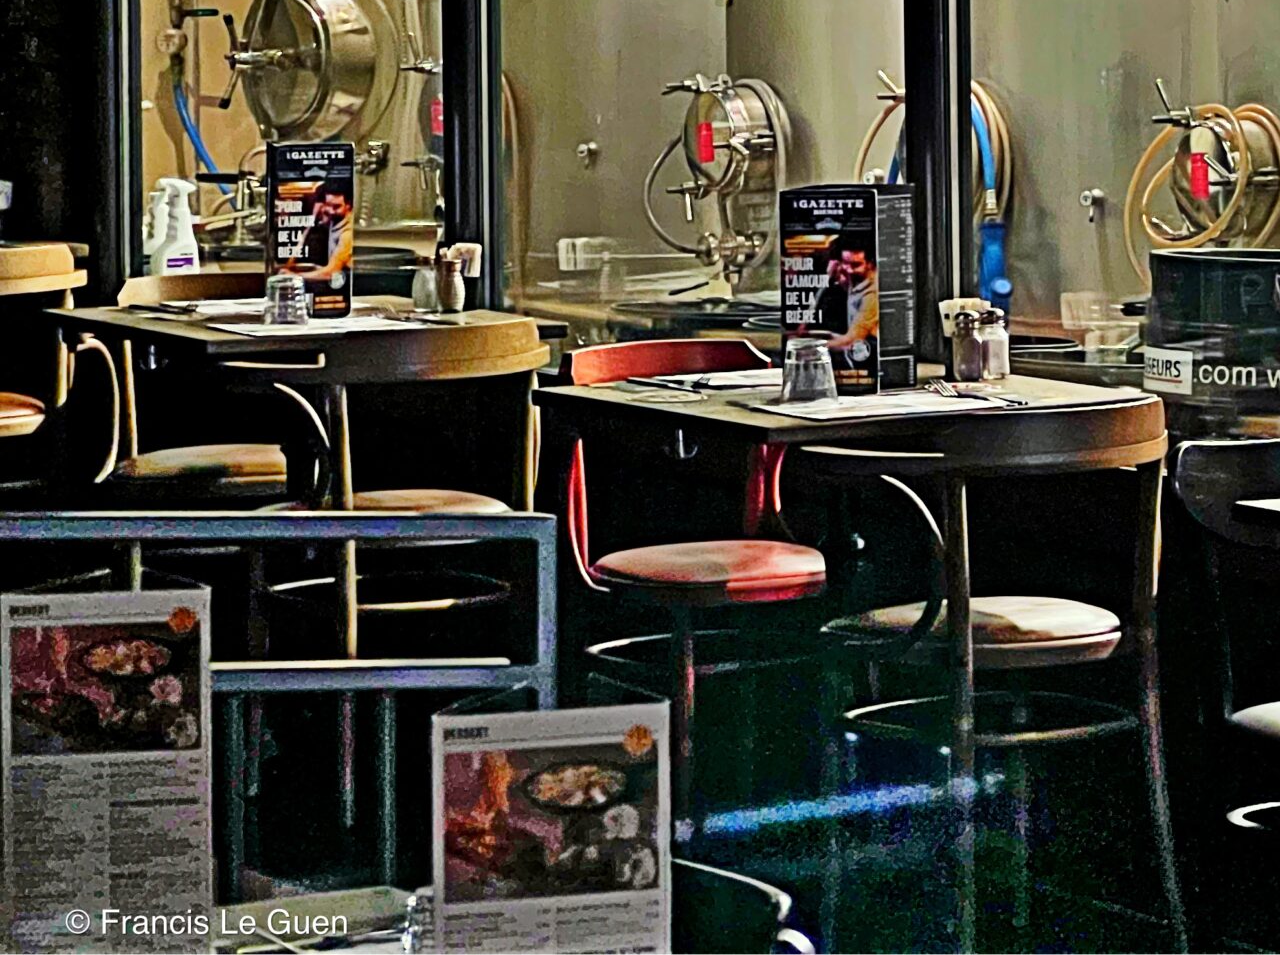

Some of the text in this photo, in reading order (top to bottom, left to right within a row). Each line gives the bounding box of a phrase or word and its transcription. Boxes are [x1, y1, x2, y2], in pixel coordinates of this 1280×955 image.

[291, 151, 345, 160] GAZETTE
[800, 199, 864, 209] GAZETTE
[785, 257, 814, 272] POUR
[785, 274, 830, 289] L'AMOUR
[785, 291, 816, 306] DE LA
[786, 307, 816, 324] BIÈRE
